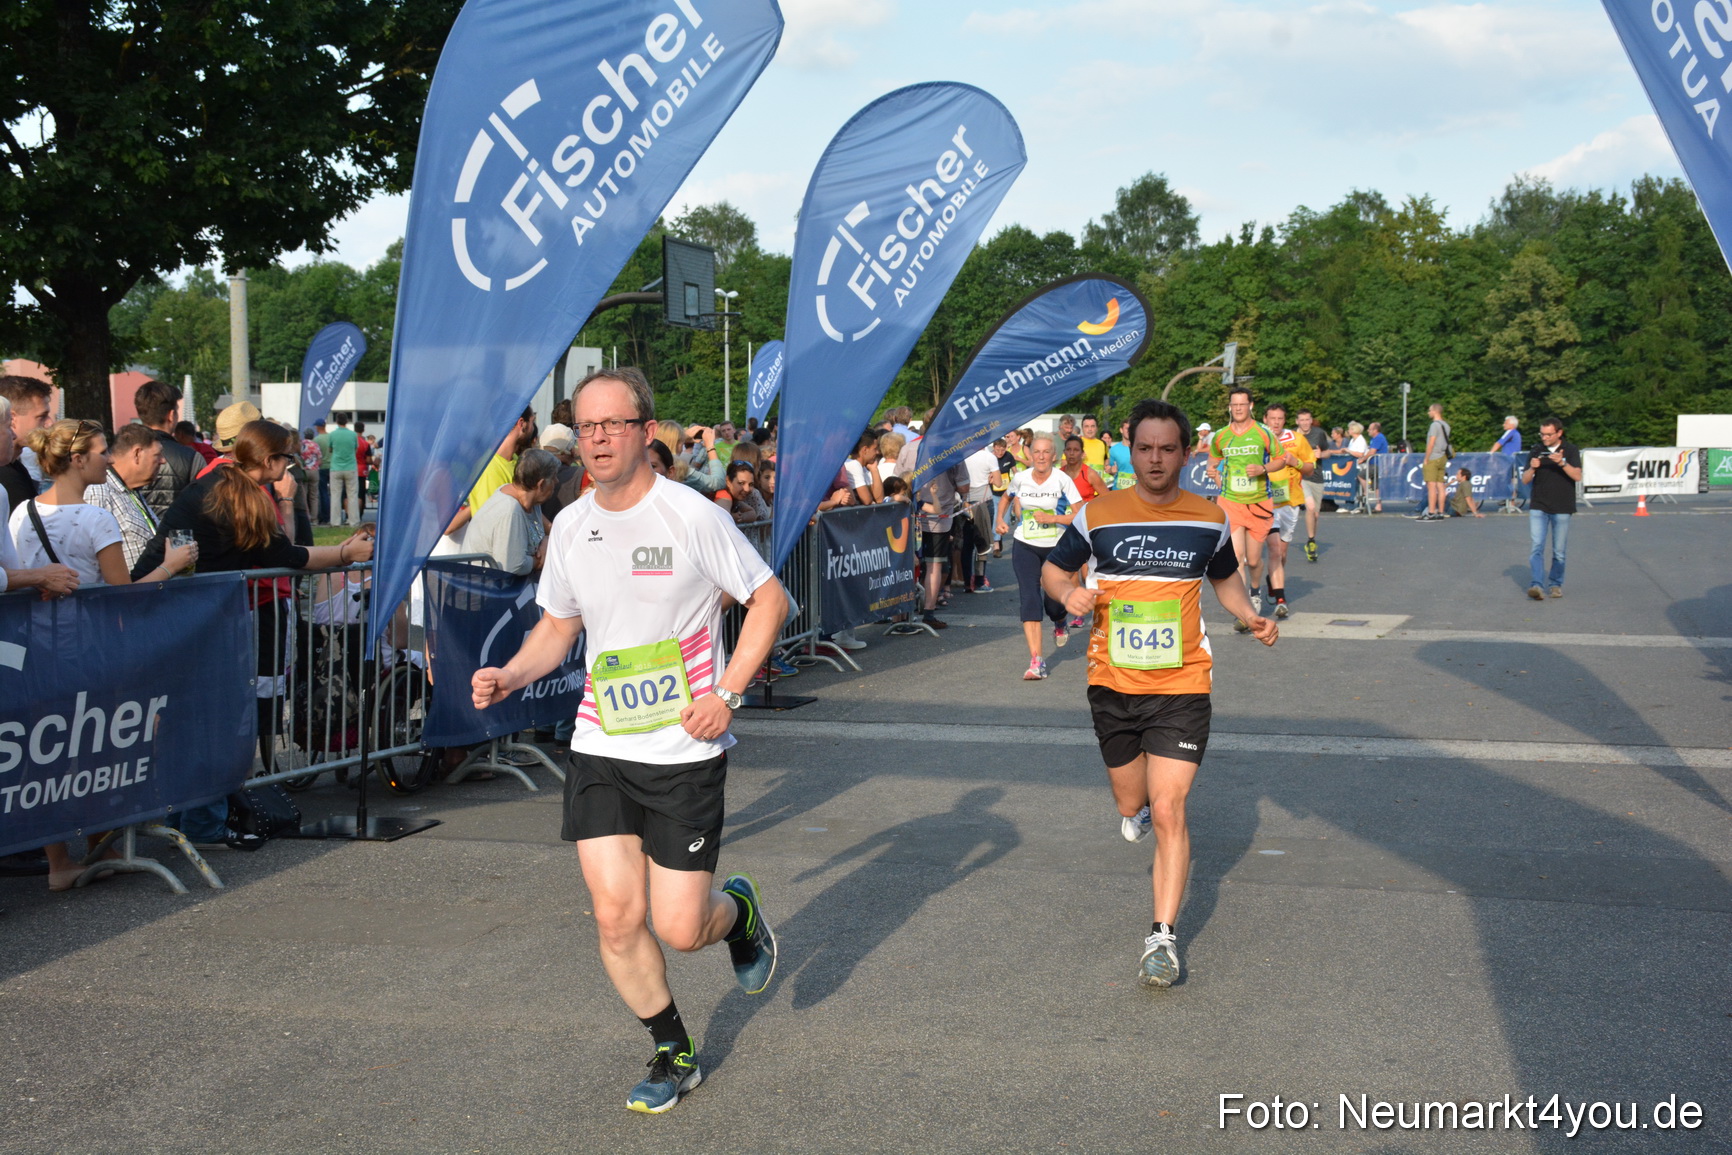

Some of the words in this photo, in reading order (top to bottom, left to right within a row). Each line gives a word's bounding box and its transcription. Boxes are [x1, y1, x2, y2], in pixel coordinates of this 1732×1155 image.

[570, 32, 725, 246] AUTOMOBILE
[847, 124, 974, 311] Fischer
[893, 160, 989, 308] AUTOMOBILE
[315, 336, 354, 397] Fischer
[758, 351, 784, 400] Fischer
[1043, 363, 1077, 387] Druck
[1077, 348, 1099, 368] und
[1098, 329, 1140, 358] Medien
[953, 337, 1091, 420] Frischmann
[912, 420, 1000, 480] www.frischmann-net.de
[1222, 445, 1259, 457] BOCK
[1627, 459, 1671, 480] swn
[827, 544, 891, 580] Frischmann
[1127, 547, 1197, 561] Fischer
[1134, 560, 1191, 569] AUTOMOBILE
[1116, 627, 1175, 650] 1643
[603, 674, 681, 712] 1002
[615, 715, 637, 723] Gerhard
[637, 707, 676, 721] Bodensteiner
[1178, 741, 1198, 751] JAKO
